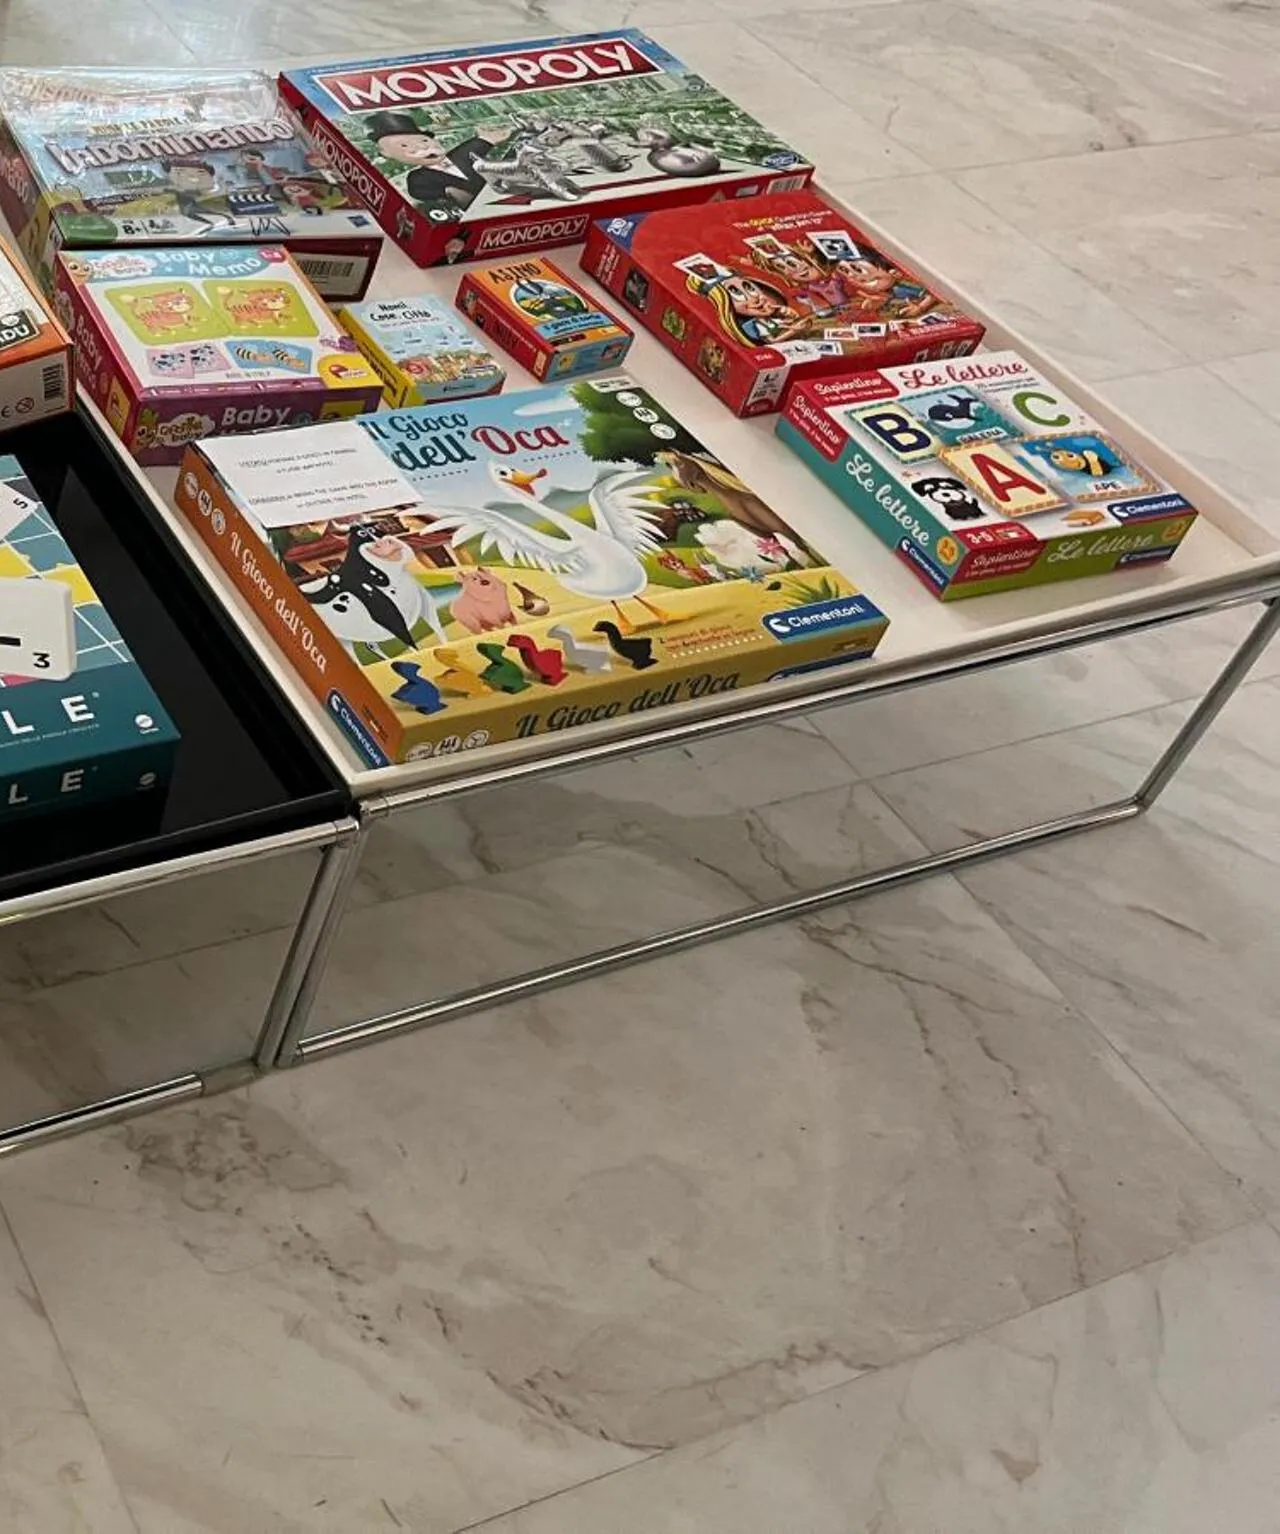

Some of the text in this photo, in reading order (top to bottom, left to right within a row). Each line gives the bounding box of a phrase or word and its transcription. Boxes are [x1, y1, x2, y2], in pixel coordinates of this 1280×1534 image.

[335, 43, 636, 108] MONOPOLY
[312, 127, 383, 206] MONOPOLY
[482, 217, 587, 249] MONOPOLY
[154, 247, 262, 277] Baby Memo
[488, 262, 543, 285] ASINO
[898, 367, 949, 390] Le
[946, 360, 1029, 384] lettere
[221, 405, 293, 427] Baby
[1012, 391, 1071, 428] C
[388, 412, 470, 441] Gioco
[862, 411, 932, 453] B
[970, 452, 1047, 503] A
[1094, 480, 1120, 491] APE
[846, 453, 930, 547] Le lettere
[1128, 498, 1187, 515] Clementoni
[1047, 533, 1154, 563] Le lettere
[229, 530, 241, 559] Il
[241, 548, 274, 600] Gioco
[786, 603, 866, 628] Clementoni
[32, 652, 51, 669] 3
[515, 713, 540, 739] Il
[546, 700, 621, 732] Gioco
